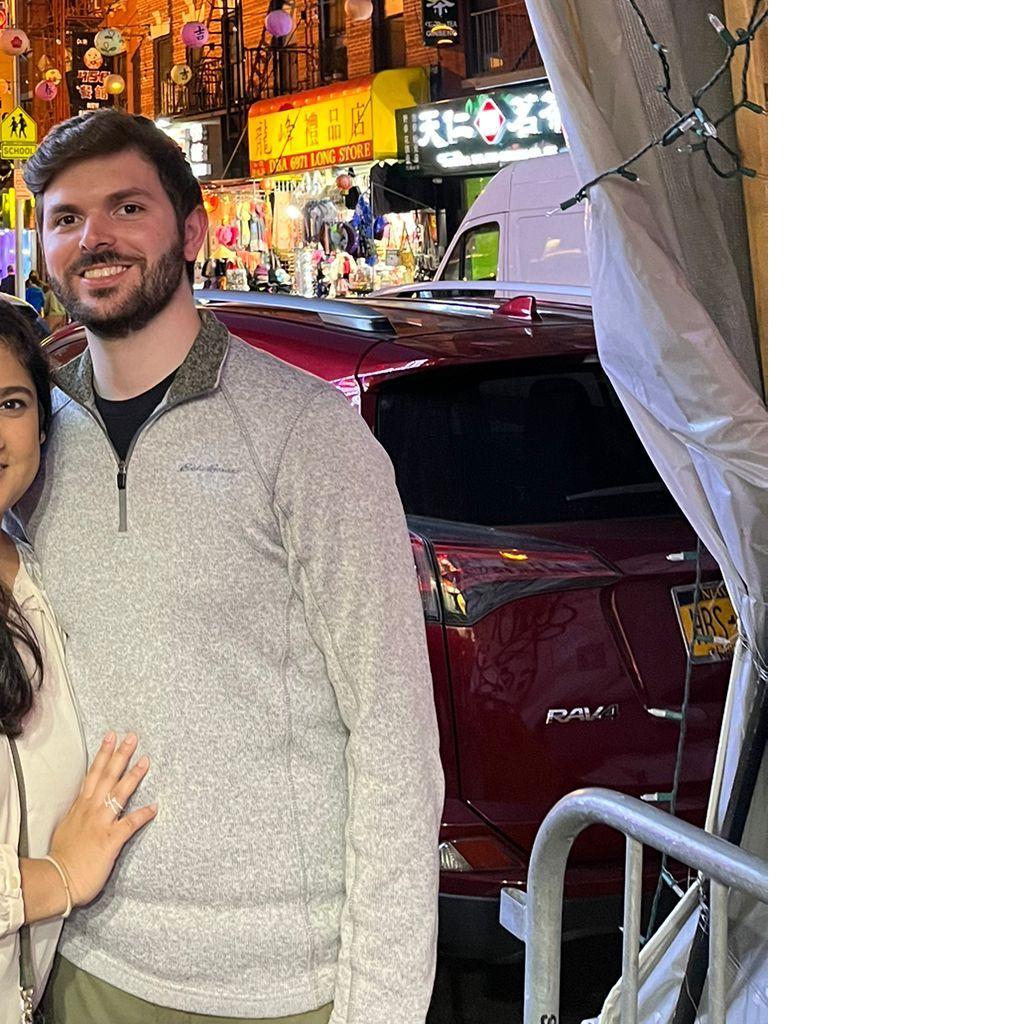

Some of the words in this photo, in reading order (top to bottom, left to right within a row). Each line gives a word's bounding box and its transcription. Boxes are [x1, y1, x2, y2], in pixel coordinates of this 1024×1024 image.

[417, 109, 475, 148] 天仁
[3, 145, 34, 156] SCHOOL
[311, 149, 336, 166] LONG
[339, 142, 371, 161] STORE
[545, 704, 620, 725] RAV4
